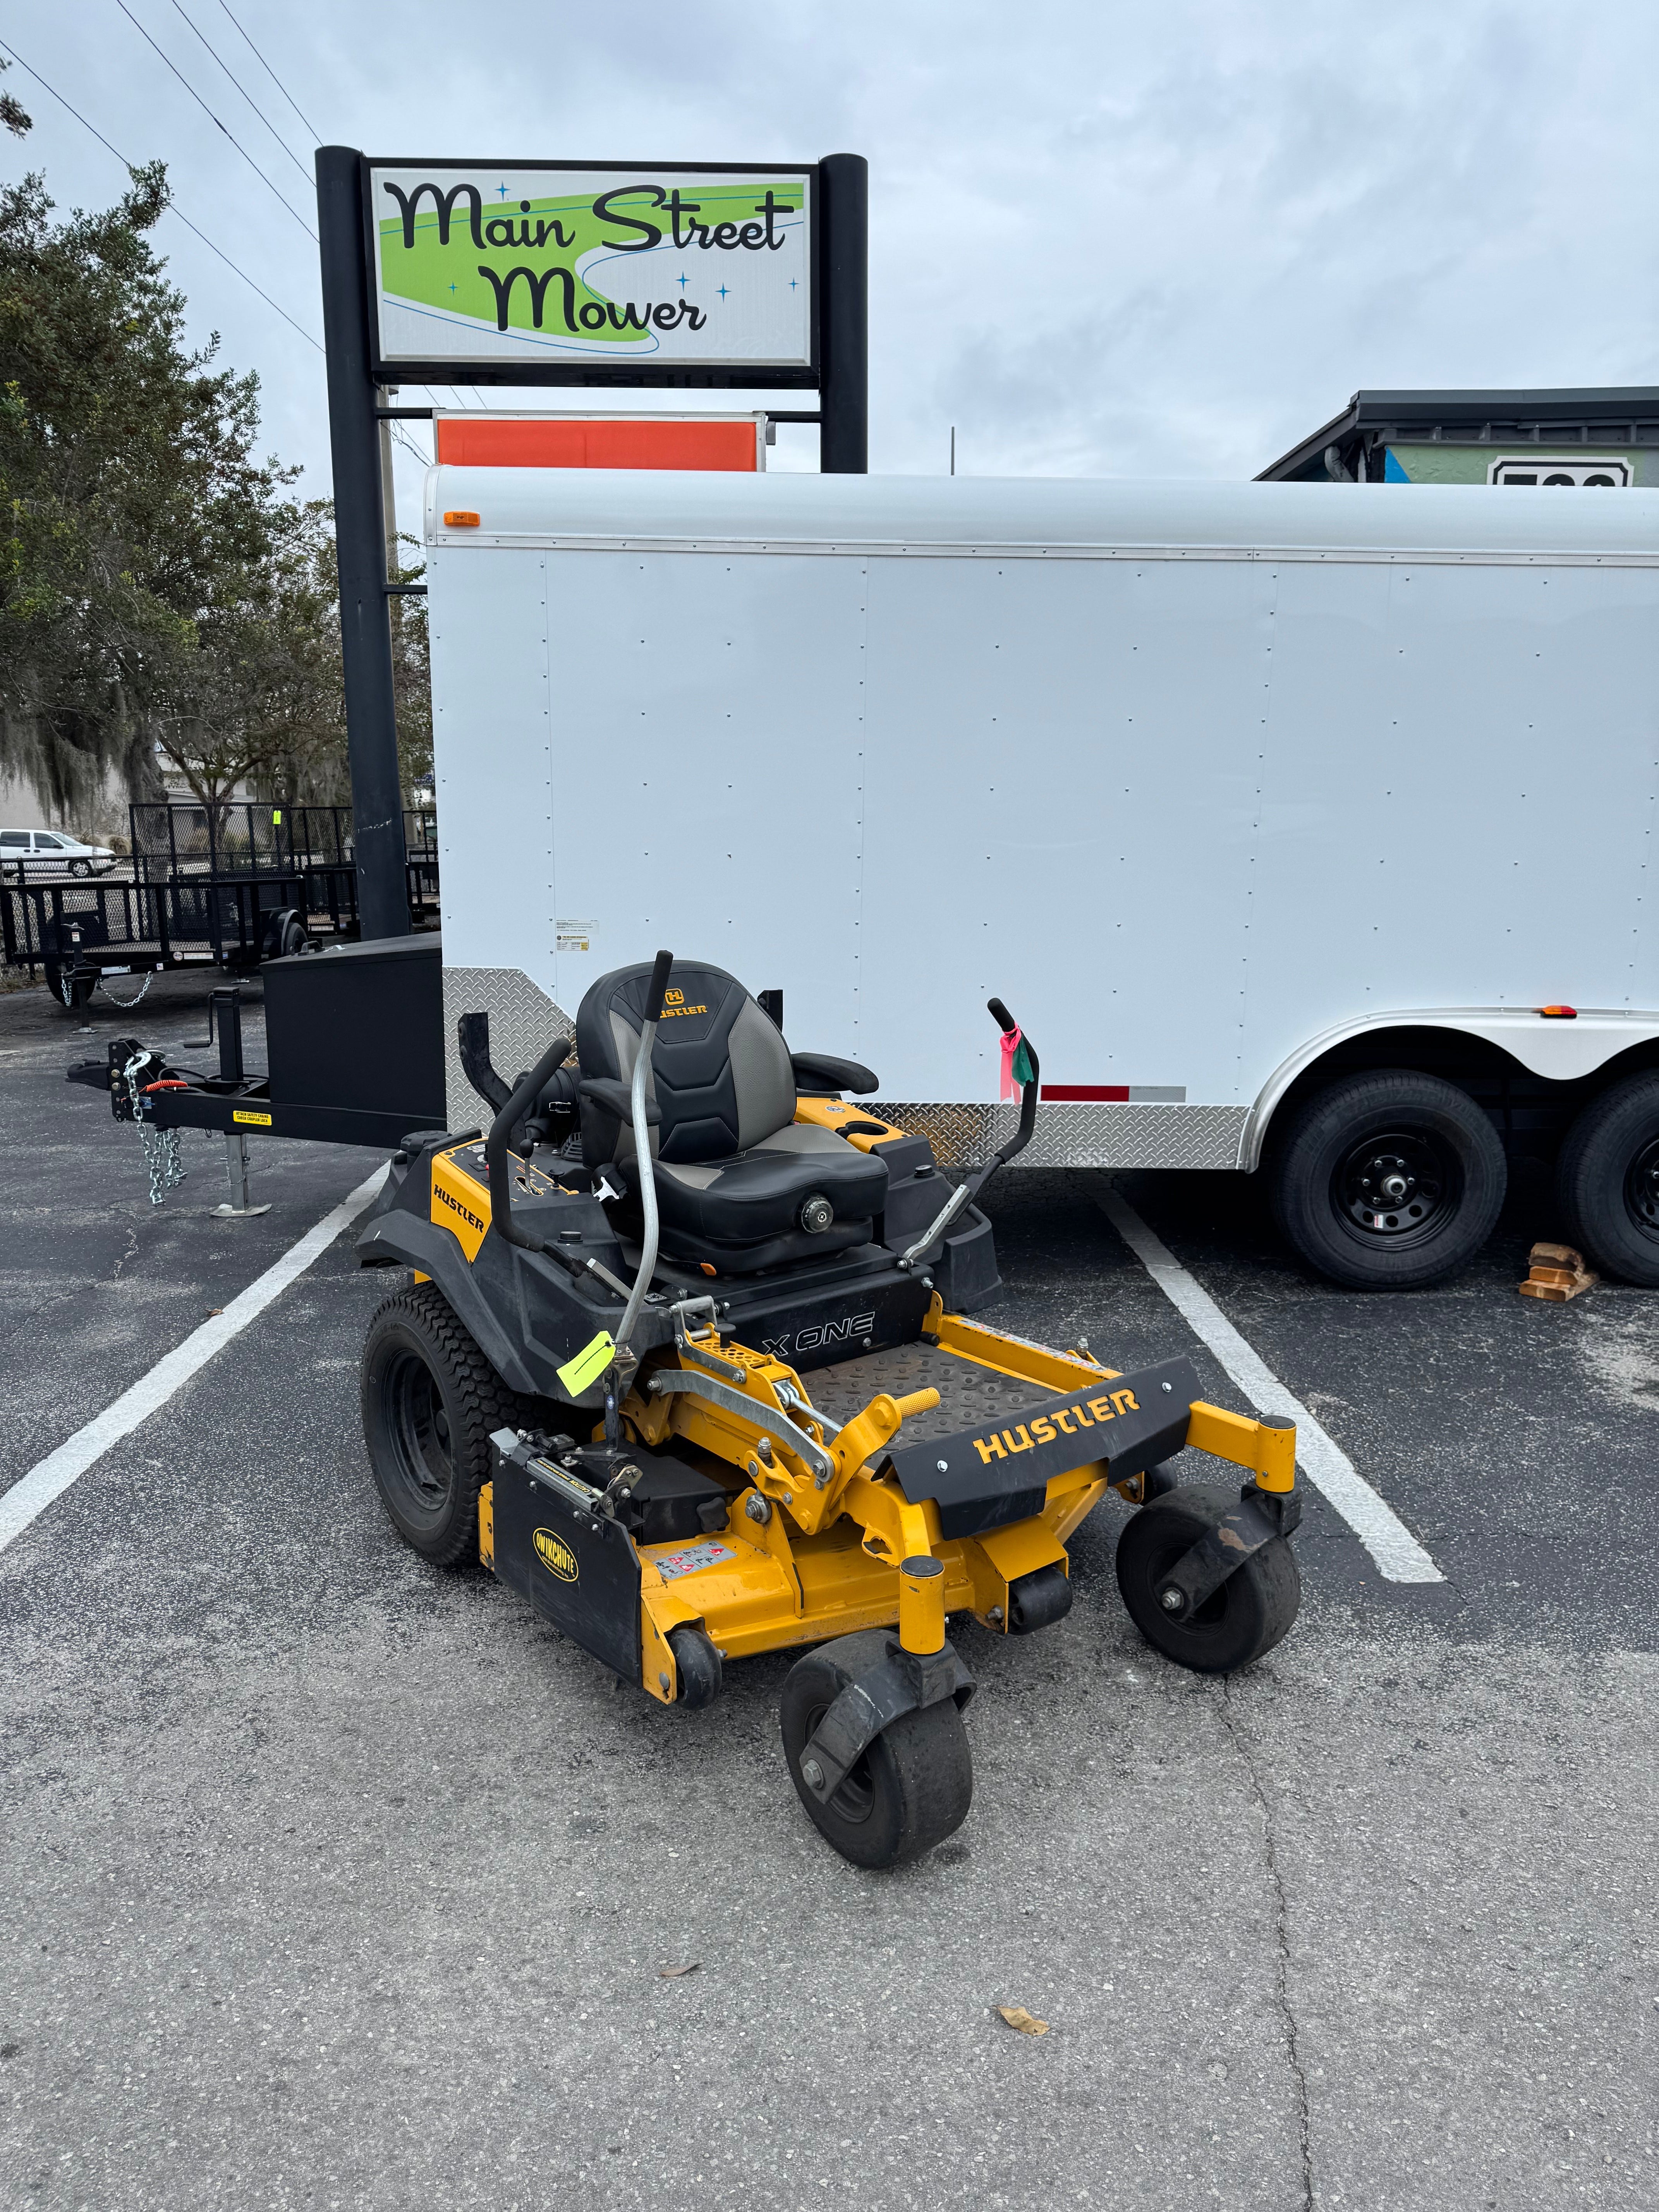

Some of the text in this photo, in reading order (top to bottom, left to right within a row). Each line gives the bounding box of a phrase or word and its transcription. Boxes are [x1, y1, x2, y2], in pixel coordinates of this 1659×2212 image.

[383, 182, 794, 251] Main Street
[478, 266, 707, 332] Mower
[660, 1005, 708, 1018] USTLER
[434, 1184, 484, 1233] HUSTLER
[762, 1311, 876, 1356] X ONE
[972, 1388, 1141, 1464] HUSTLER
[569, 1480, 590, 1493] CAUTION
[536, 1532, 574, 1573] QWIKCHUTE
